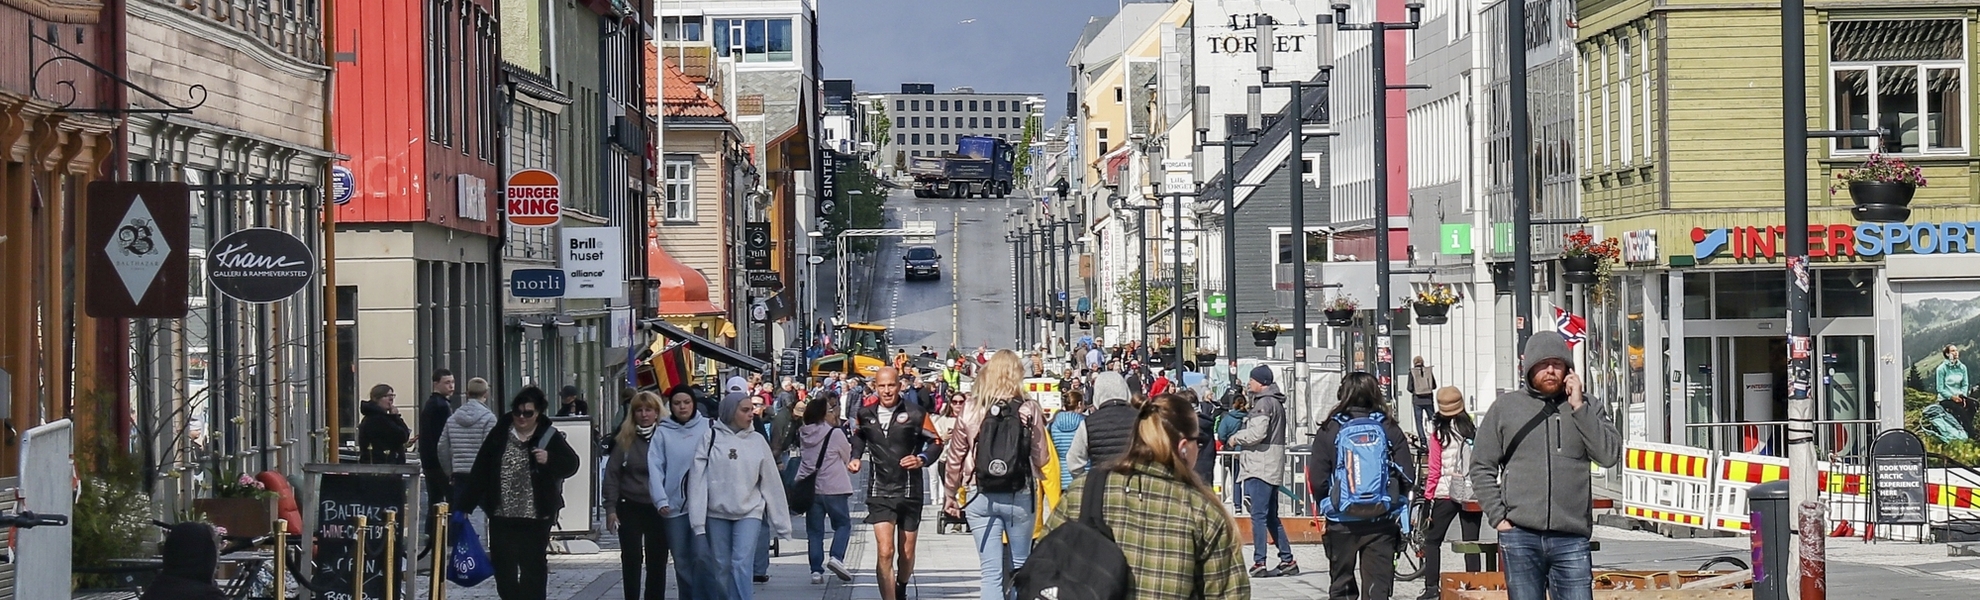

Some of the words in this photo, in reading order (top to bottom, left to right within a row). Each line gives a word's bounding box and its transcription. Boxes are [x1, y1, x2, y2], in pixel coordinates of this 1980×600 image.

[1229, 13, 1282, 31] Lile
[1207, 35, 1305, 54] TORET
[823, 151, 833, 198] SINTEF
[508, 187, 559, 199] BURGER
[508, 199, 559, 215] KING
[570, 250, 604, 261] huset
[516, 275, 560, 290] norli
[321, 500, 399, 521] BALTHAZ
